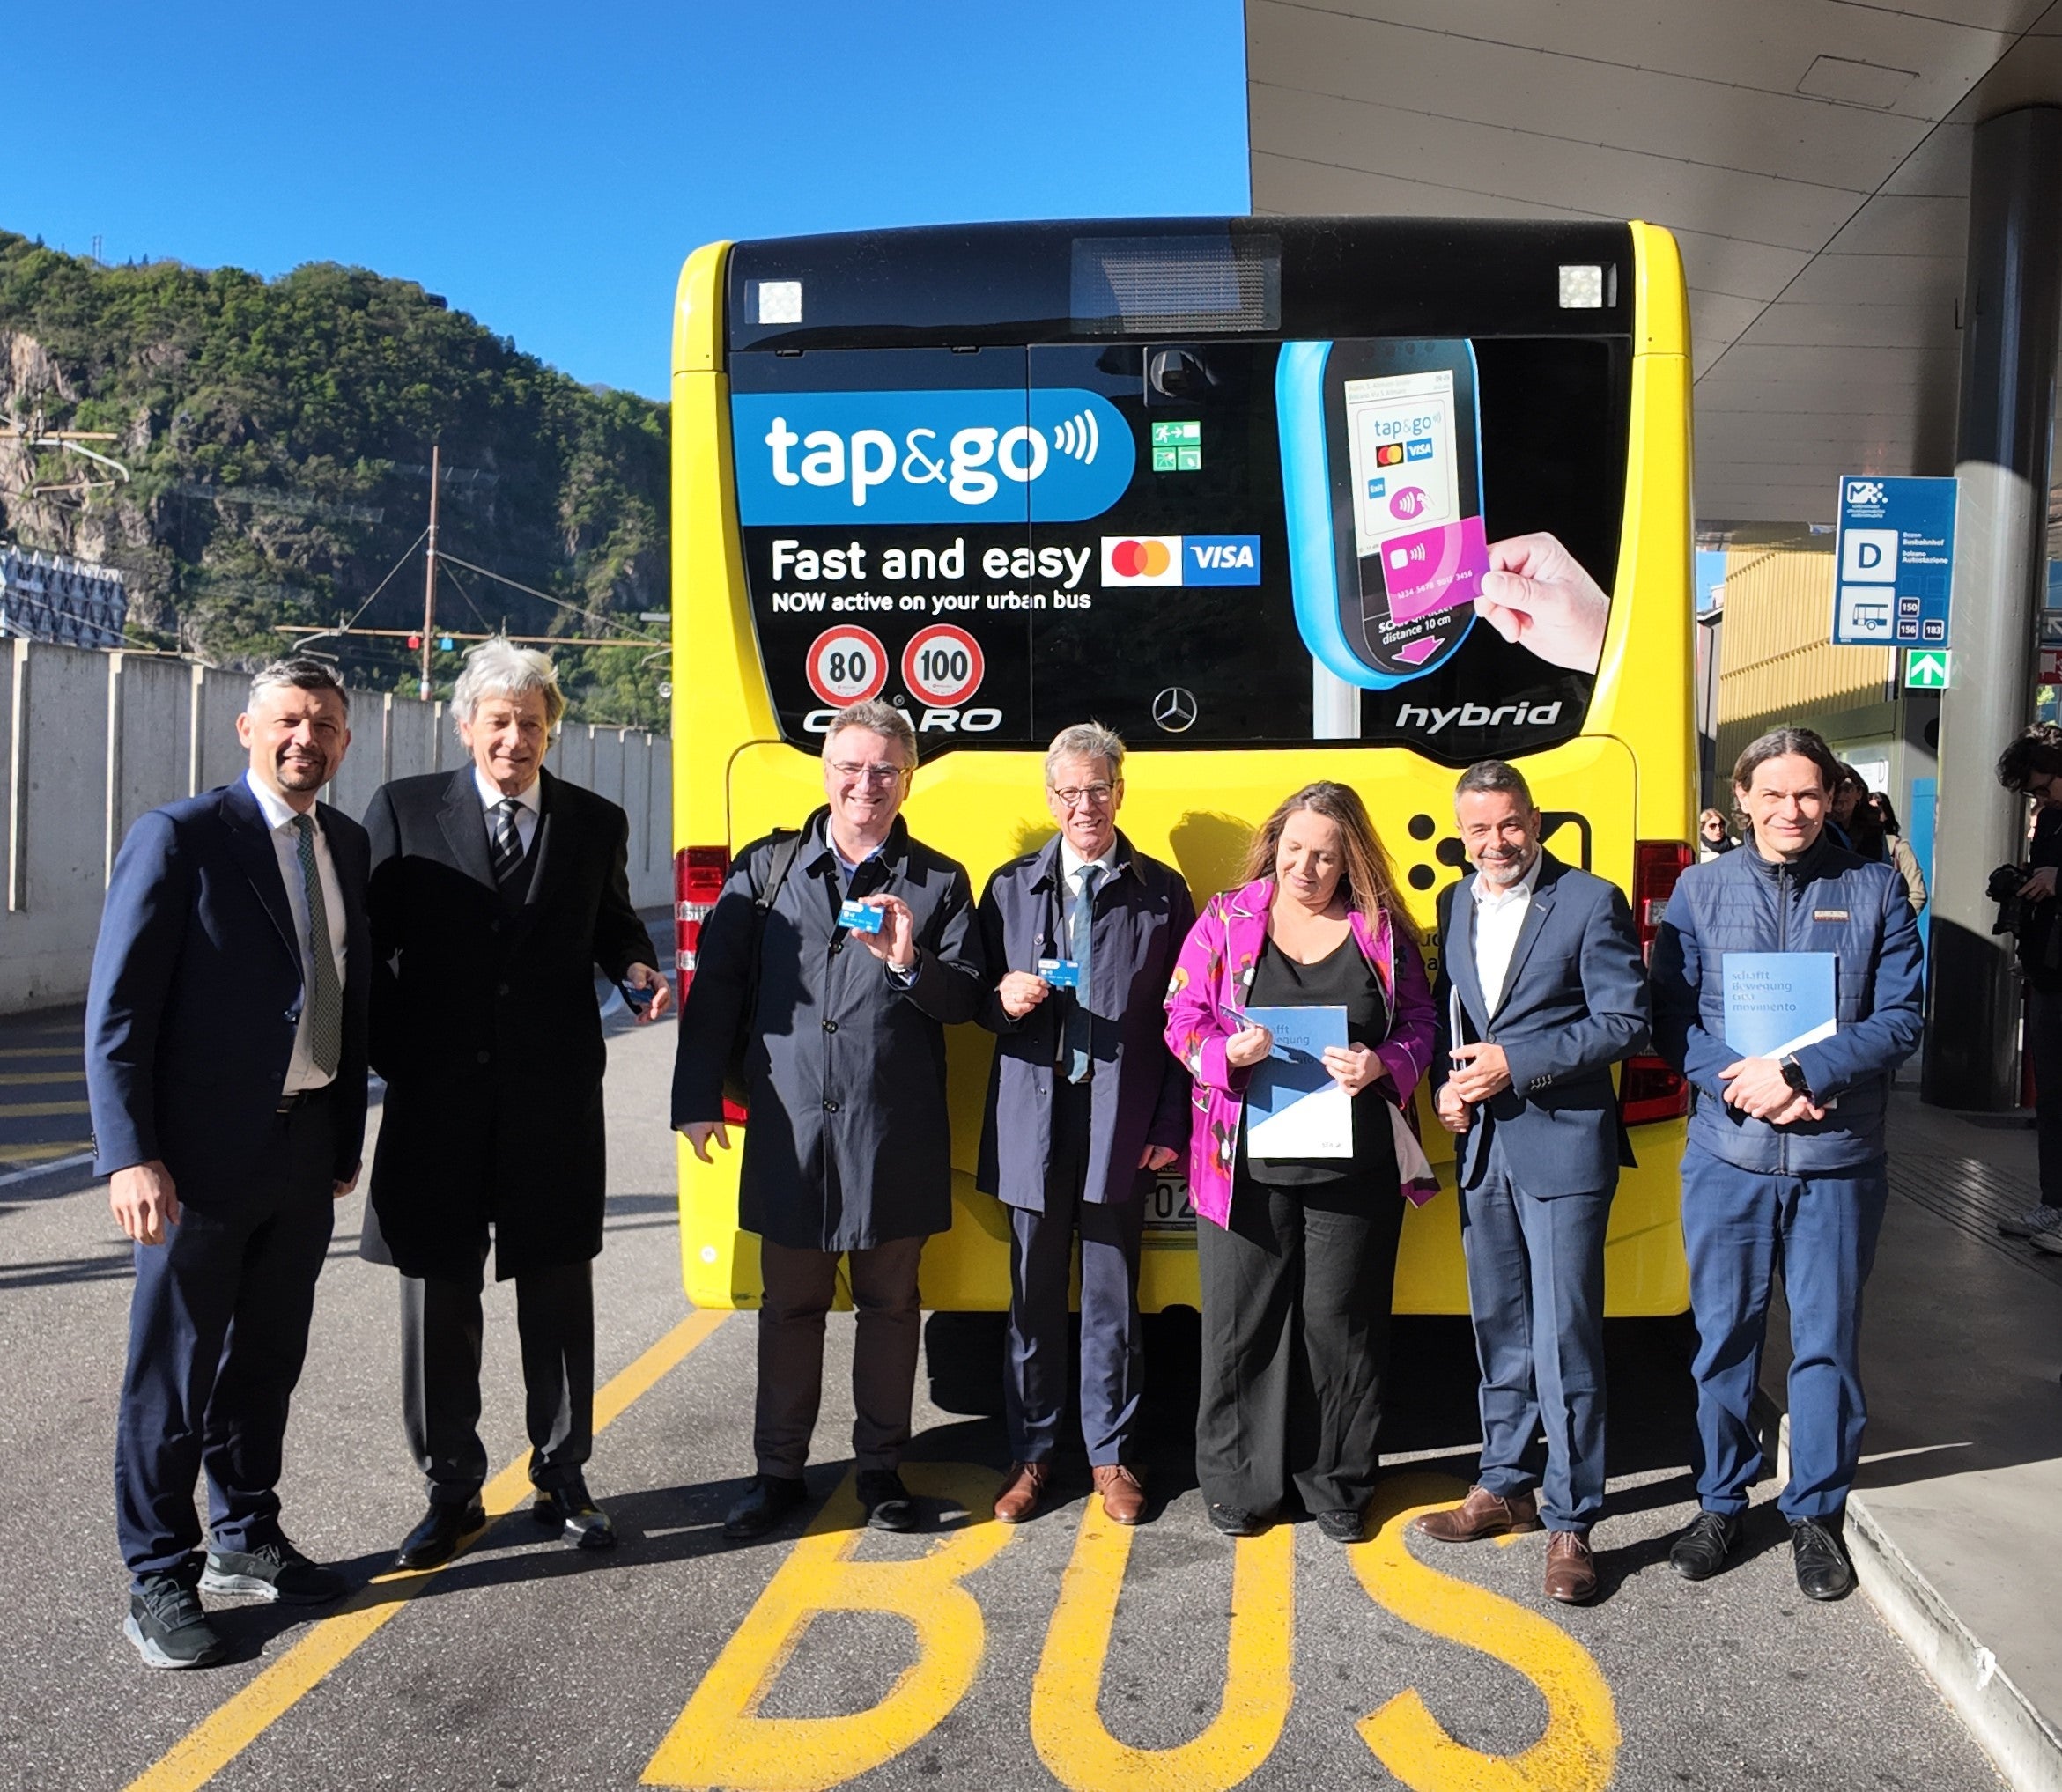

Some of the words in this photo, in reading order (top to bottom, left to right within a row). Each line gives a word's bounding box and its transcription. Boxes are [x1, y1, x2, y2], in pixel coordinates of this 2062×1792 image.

[1374, 416, 1432, 439] tap&go
[765, 417, 1049, 507] tap&go
[772, 538, 867, 581] Fast
[881, 536, 964, 580] and
[981, 546, 1091, 588] easy
[1190, 543, 1254, 569] VISA
[1858, 542, 1882, 569] D
[772, 591, 826, 612] NOW
[831, 592, 893, 611] active
[898, 595, 925, 610] on
[931, 594, 980, 615] your
[986, 590, 1047, 610] urban
[1053, 589, 1092, 608] bus
[1902, 603, 1918, 612] 150
[1382, 626, 1423, 645] distance
[1424, 618, 1436, 631] 10
[1437, 615, 1452, 627] cm
[829, 651, 867, 682] 80
[920, 650, 968, 682] 100
[1395, 701, 1563, 734] hybrid
[639, 1462, 1622, 1792] BUS
